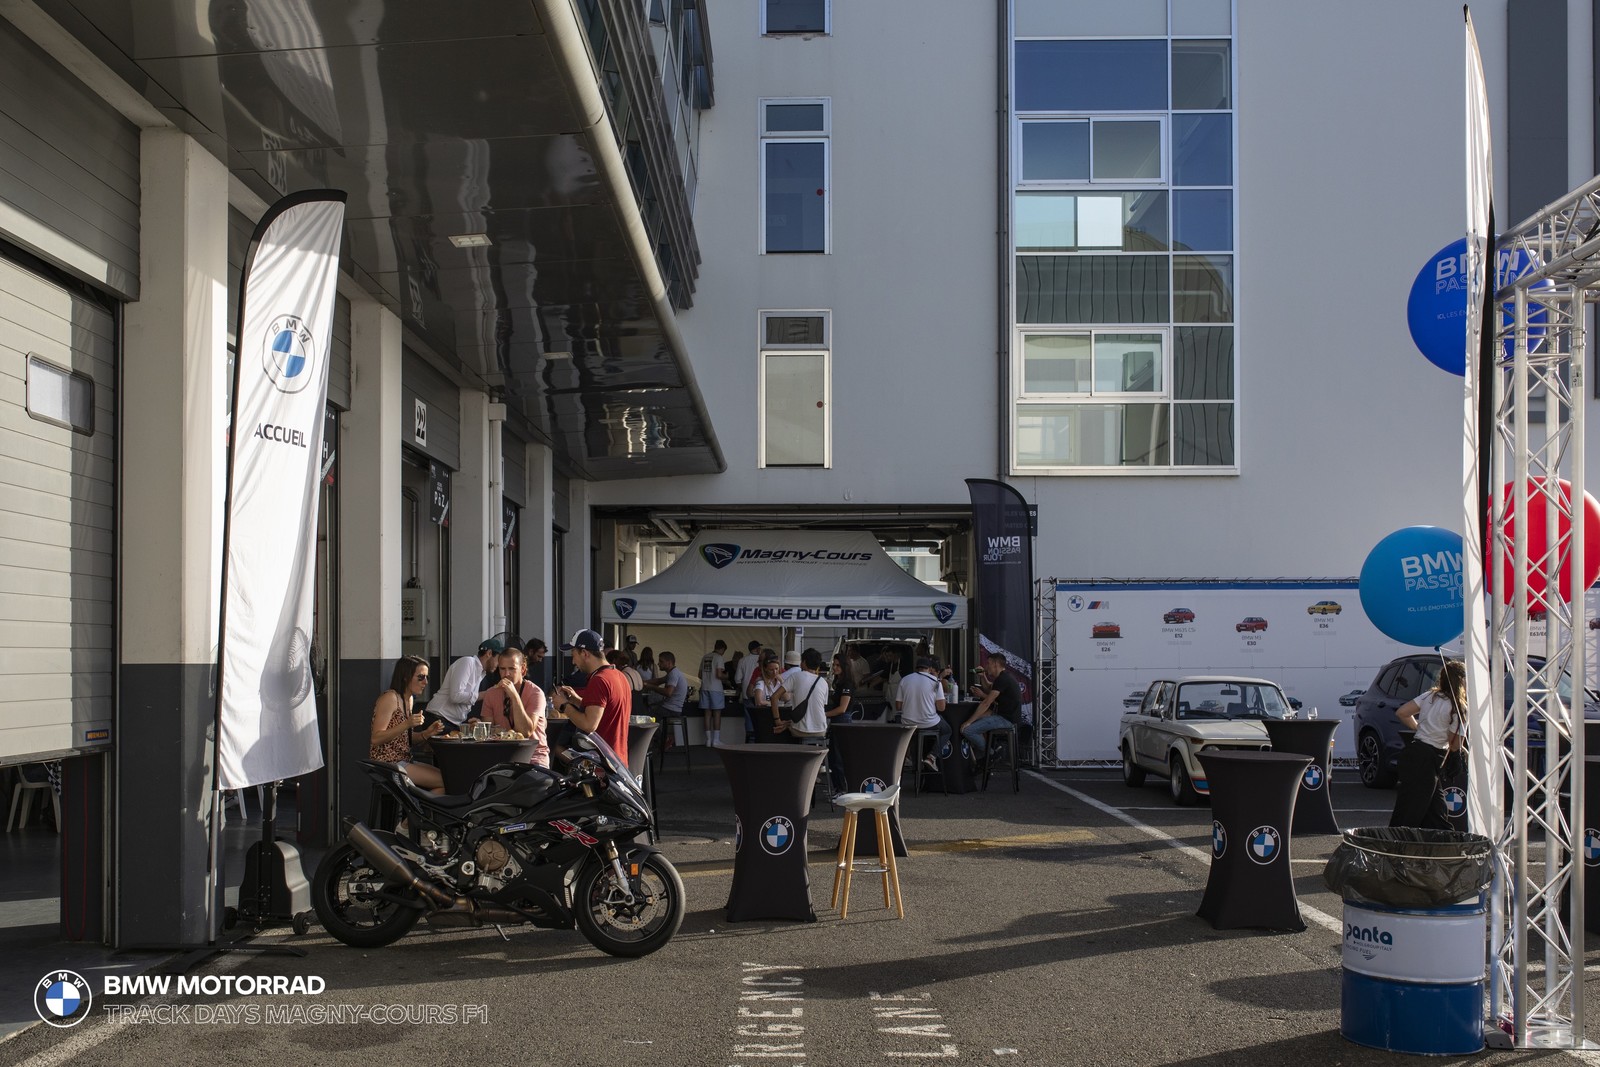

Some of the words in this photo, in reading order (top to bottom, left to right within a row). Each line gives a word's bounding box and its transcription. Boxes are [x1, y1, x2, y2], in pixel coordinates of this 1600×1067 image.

[272, 319, 310, 344] BMW
[254, 423, 306, 448] ACCUEIL
[740, 549, 872, 561] Magny-Cours
[765, 818, 791, 829] BMW
[1252, 827, 1278, 839] BMW
